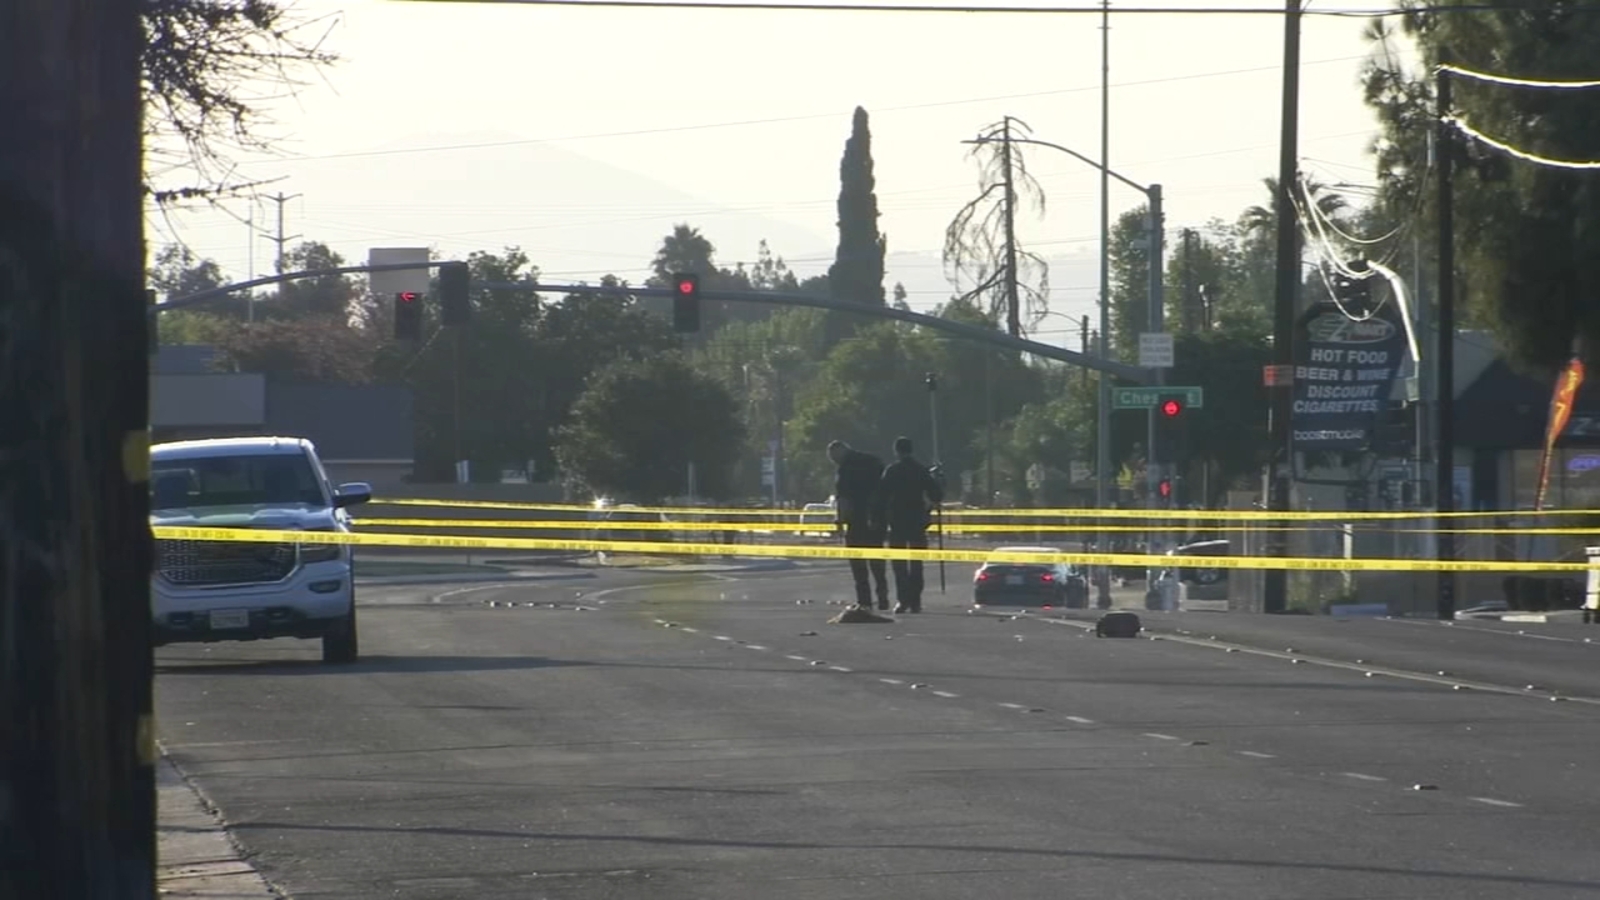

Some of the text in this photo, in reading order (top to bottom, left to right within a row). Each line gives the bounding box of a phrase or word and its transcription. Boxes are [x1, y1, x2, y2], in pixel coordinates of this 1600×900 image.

[1311, 349, 1388, 363] HOT FOOD
[1295, 366, 1339, 380] BEER
[1342, 370, 1353, 381] &
[1357, 368, 1390, 380] WINE
[1306, 385, 1379, 398] DISCOUNT
[1293, 400, 1379, 413] CIGARETTES
